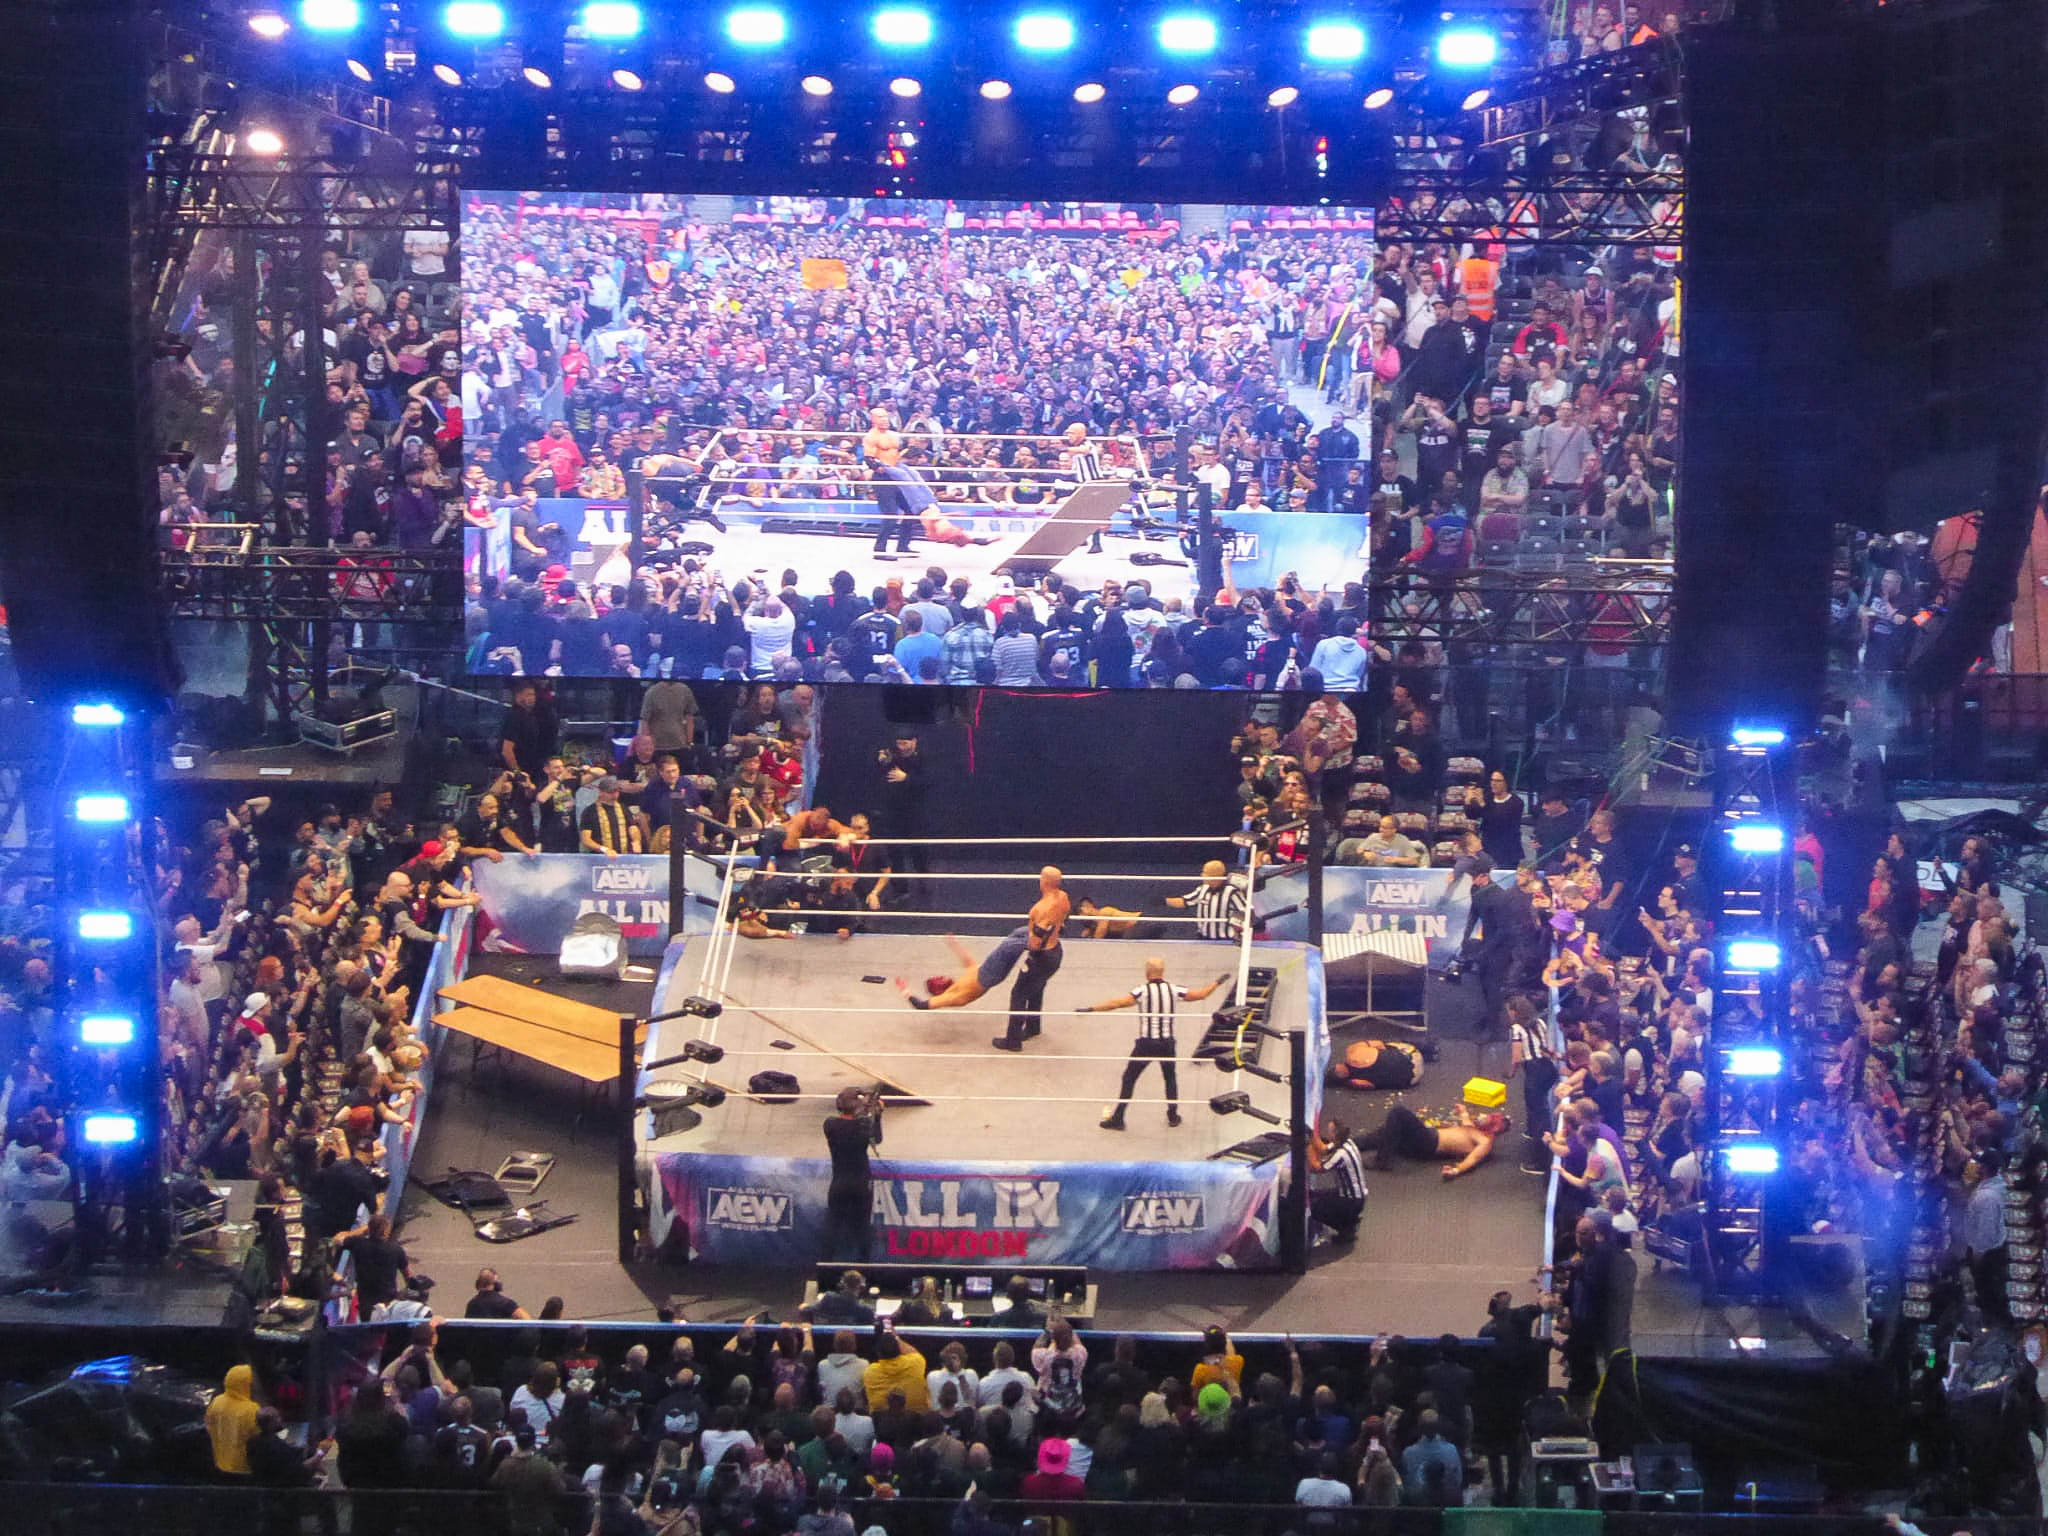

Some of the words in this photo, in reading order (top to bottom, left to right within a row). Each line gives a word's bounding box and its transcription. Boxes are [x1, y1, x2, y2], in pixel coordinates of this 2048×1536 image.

[596, 869, 652, 890] AEW
[1370, 882, 1426, 904] AEW
[1349, 913, 1408, 936] ALL
[1413, 914, 1448, 938] IN
[711, 1192, 788, 1225] AEW
[871, 1180, 977, 1228] ALL
[993, 1180, 1060, 1228] IN
[1126, 1198, 1201, 1229] AEW
[886, 1229, 1029, 1258] LONDON
